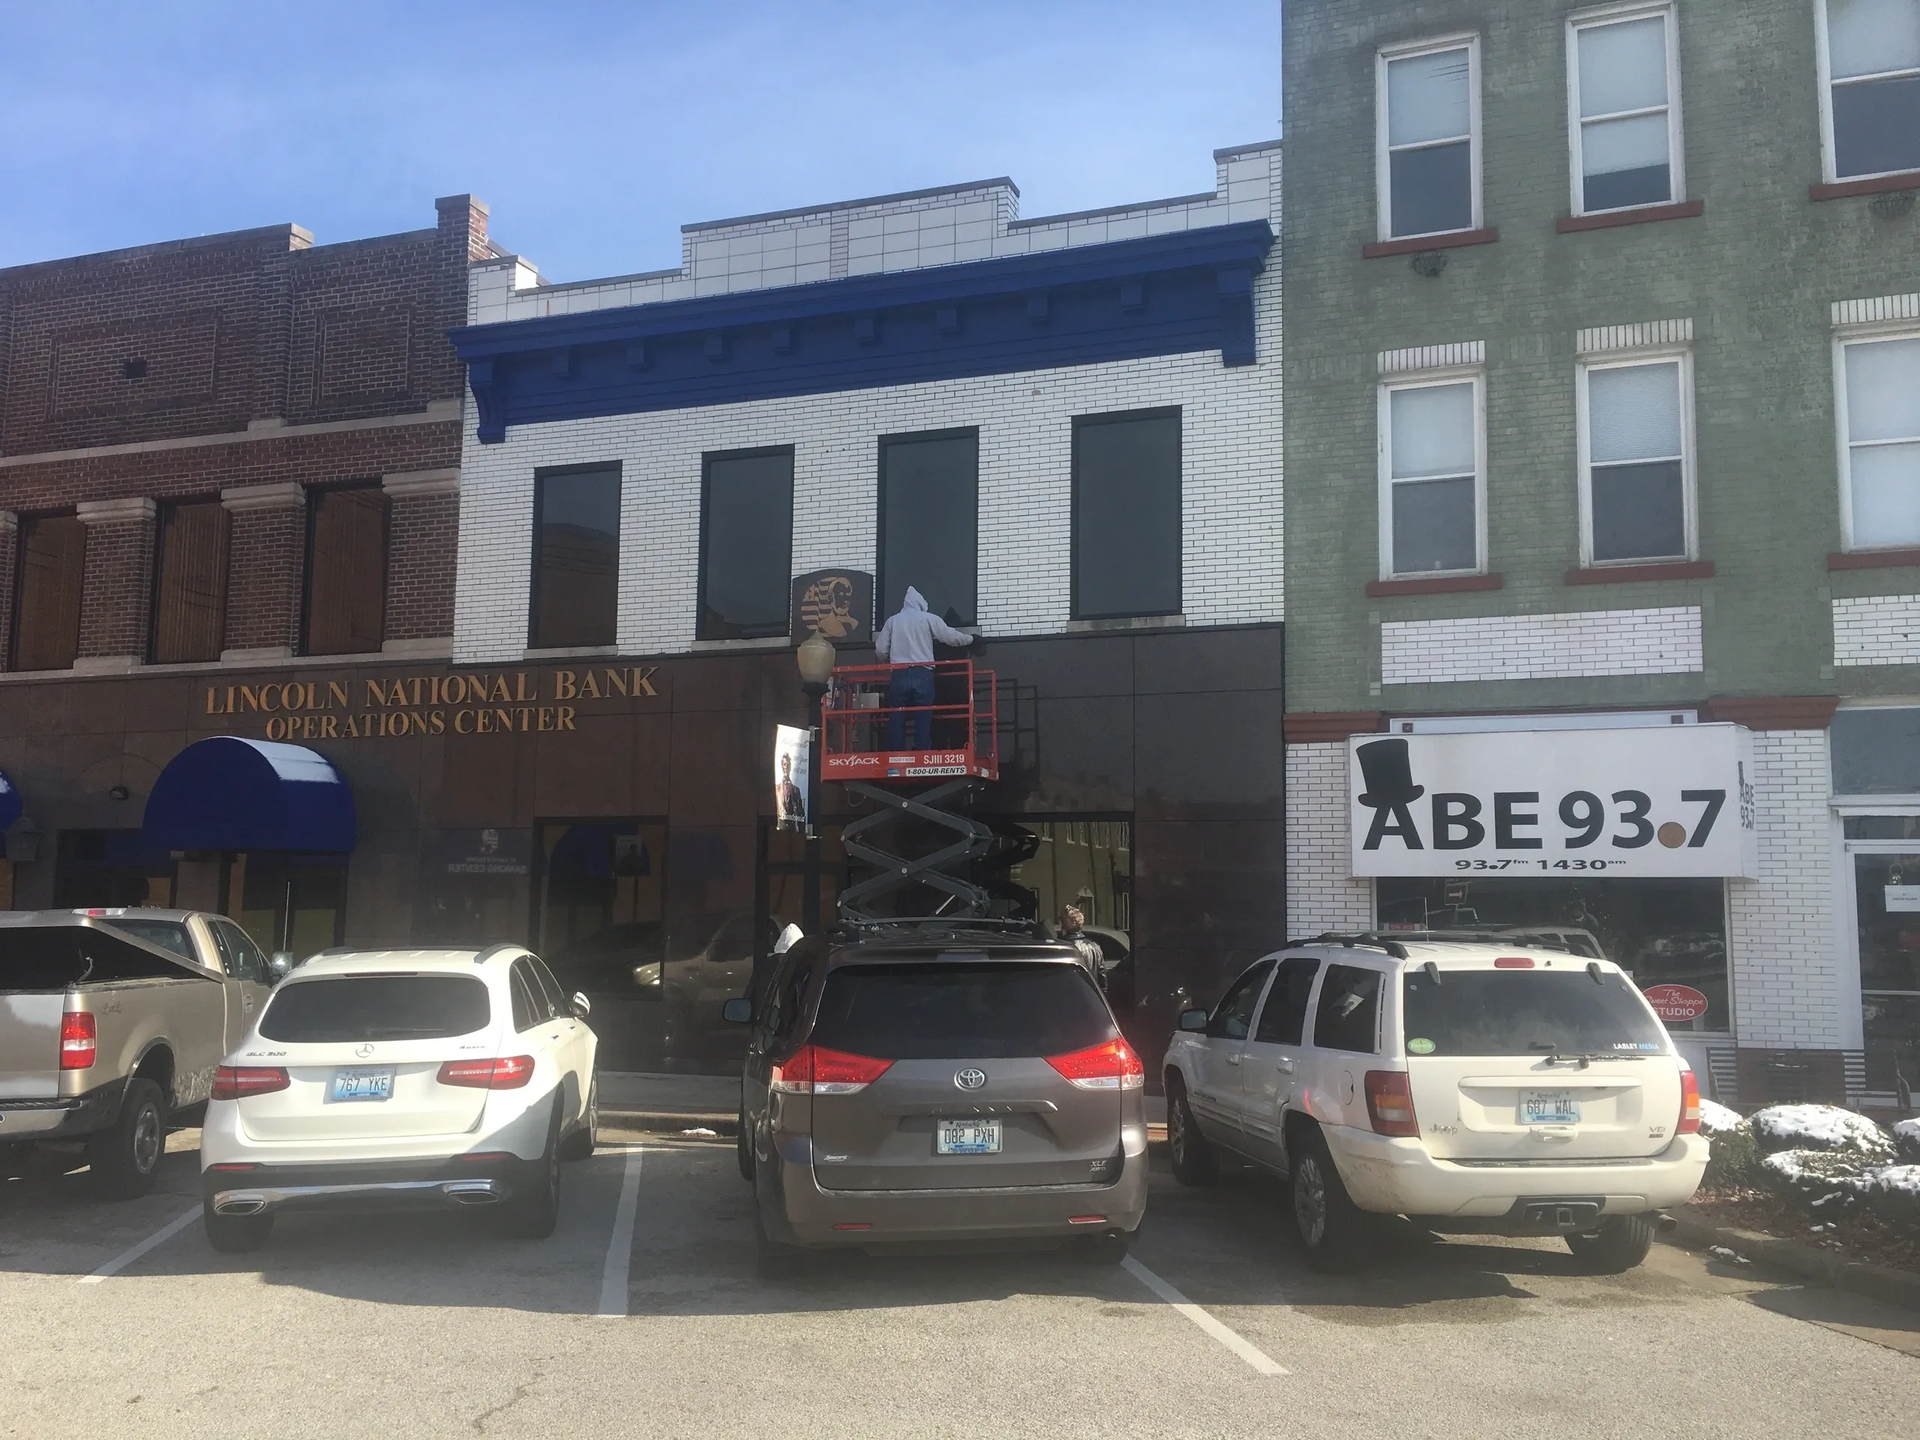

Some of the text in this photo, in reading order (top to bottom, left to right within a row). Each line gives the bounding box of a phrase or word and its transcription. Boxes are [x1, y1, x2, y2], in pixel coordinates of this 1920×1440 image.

[206, 666, 660, 715] LINCOLN NATIONAL BANK
[266, 706, 577, 741] OPERATIONS CENTER
[828, 754, 880, 767] SKYJACK
[944, 753, 965, 764] 3219
[907, 766, 966, 775] 1-800-UR-RENTS
[1739, 782, 1755, 807] ABE
[1362, 789, 1727, 851] ABE 93.7
[1663, 988, 1681, 997] The
[1669, 996, 1704, 1007] Shoppe
[1612, 1042, 1638, 1050] LASLEY
[340, 1077, 388, 1092] 767 YKE
[1555, 1099, 1576, 1115] WAL
[944, 1128, 995, 1144] 082 PXH
[1429, 1123, 1458, 1136] Jeep
